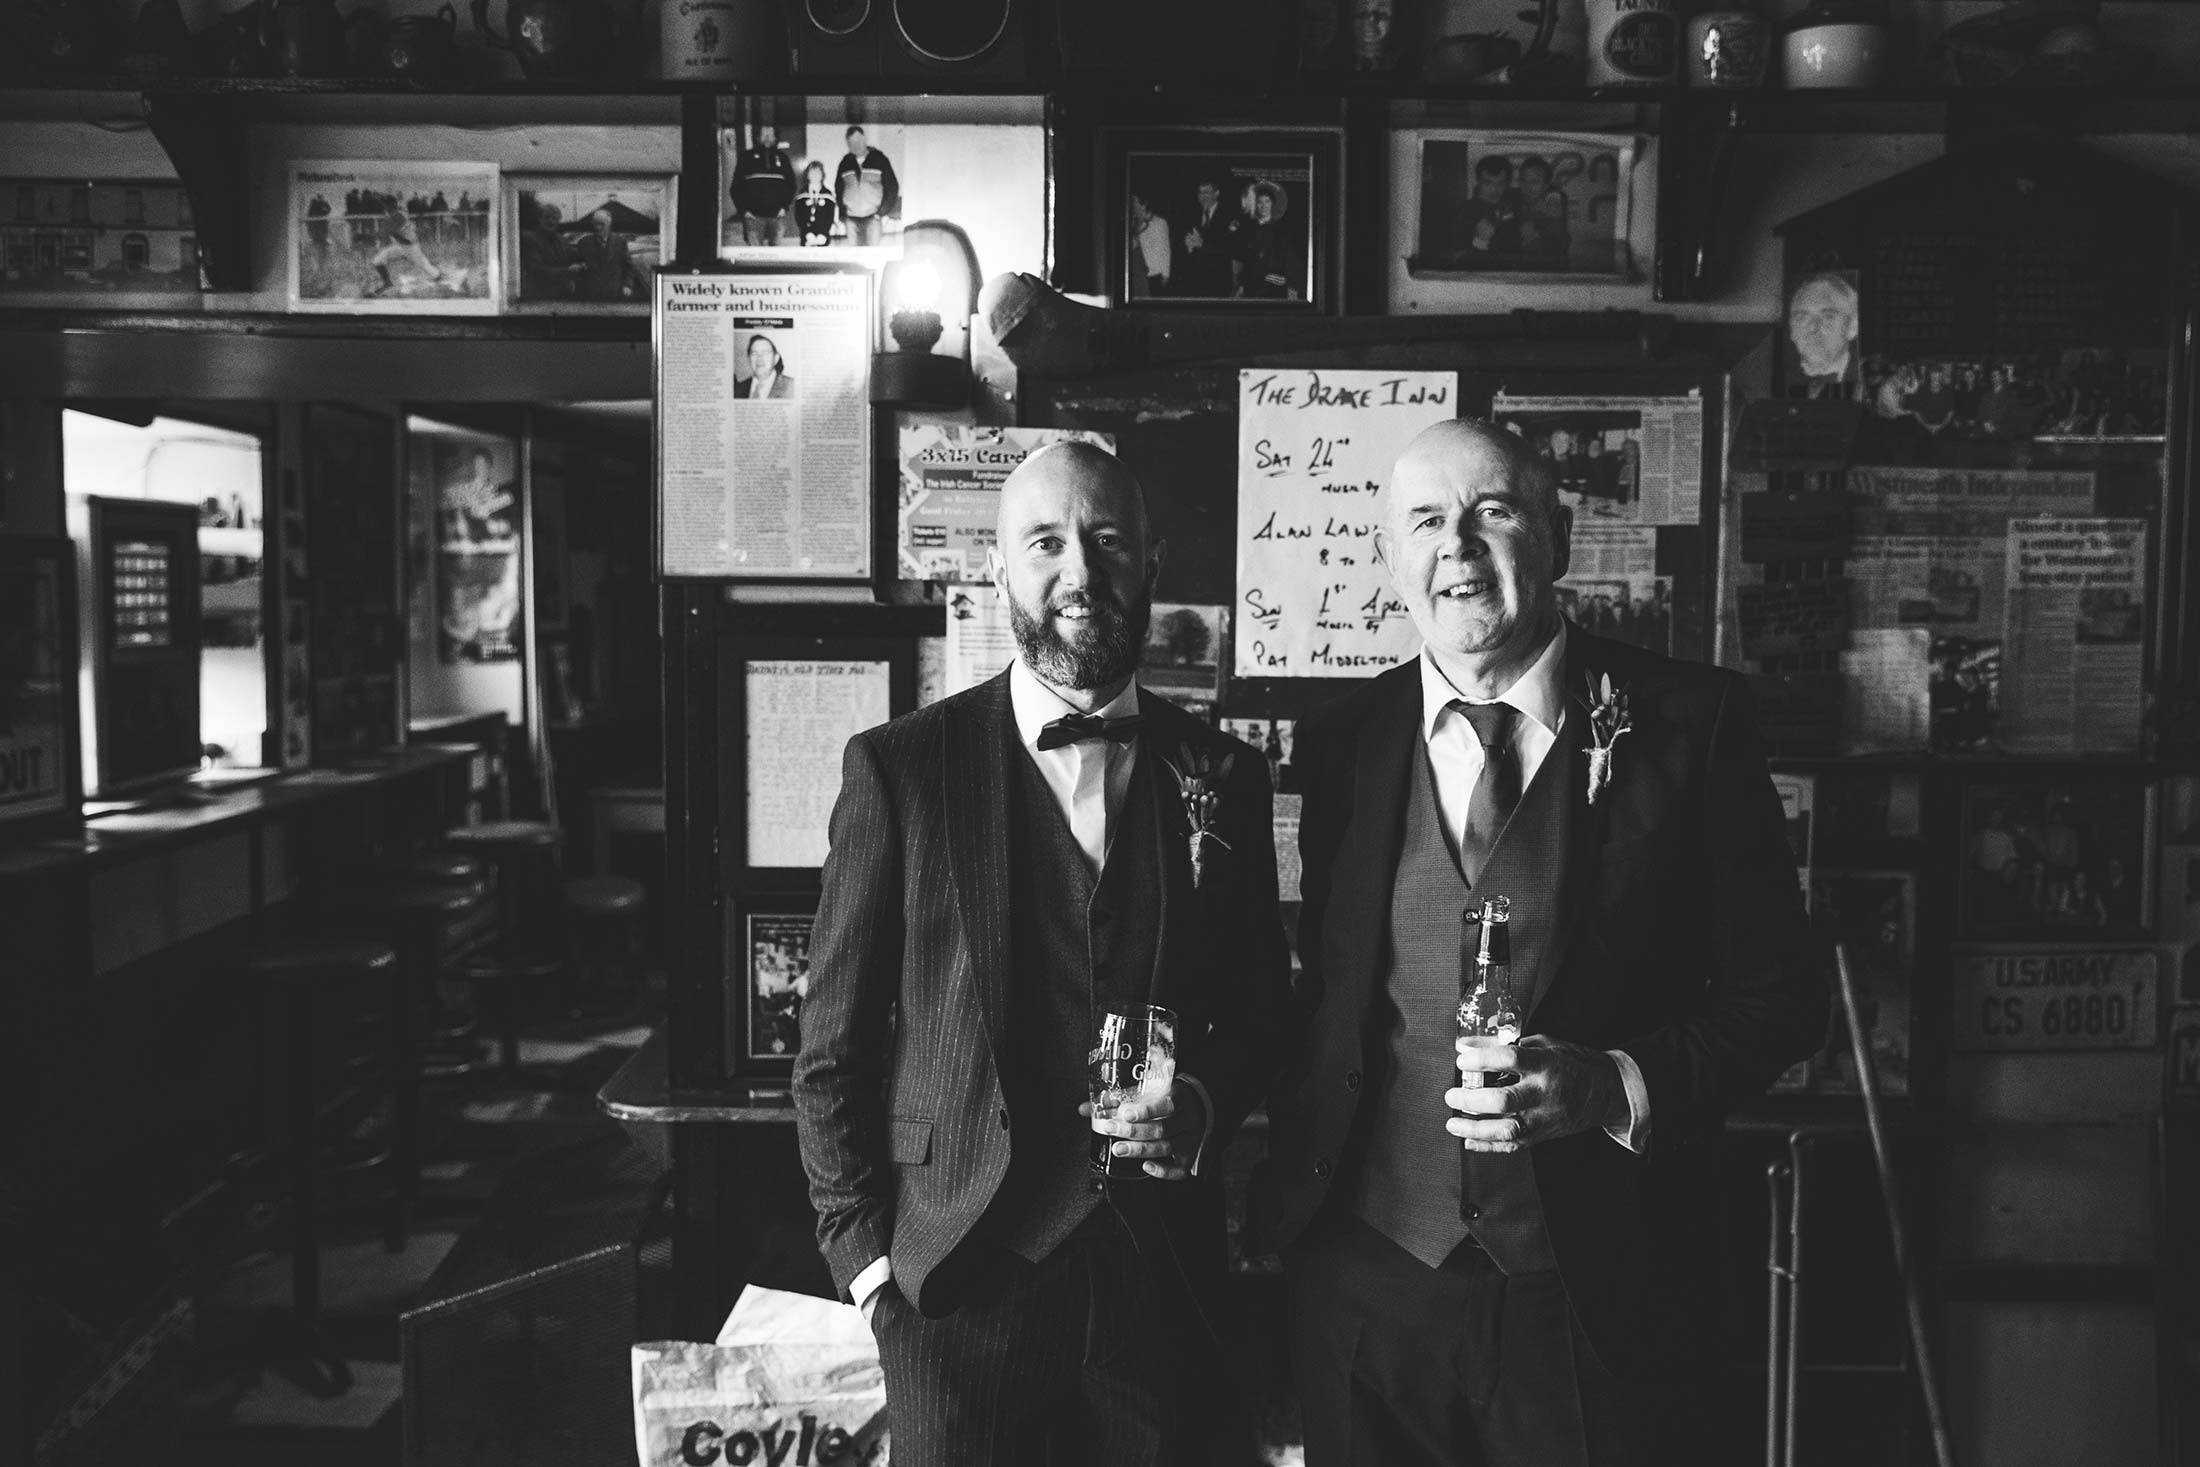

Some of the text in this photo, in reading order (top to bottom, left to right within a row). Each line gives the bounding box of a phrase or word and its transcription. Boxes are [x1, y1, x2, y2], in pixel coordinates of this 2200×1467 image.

[672, 283, 725, 298] Widely
[729, 283, 782, 297] known
[667, 300, 718, 312] farmer
[725, 300, 754, 312] and
[1248, 371, 1447, 410] THE DRAKE INN
[1252, 510, 1312, 541] ALAN
[1319, 548, 1330, 566] 8
[1982, 994, 2126, 1037] CS 6880
